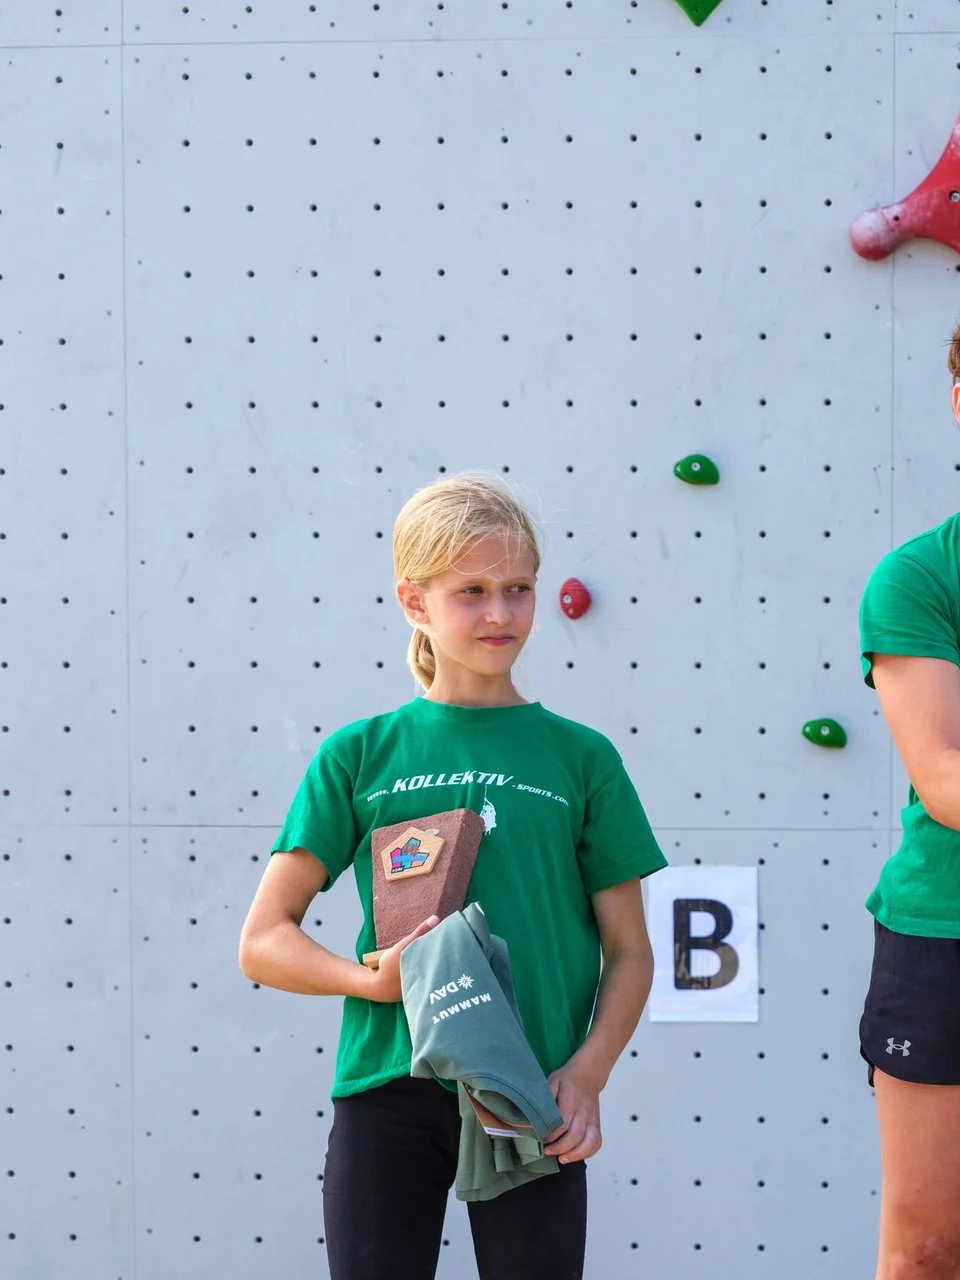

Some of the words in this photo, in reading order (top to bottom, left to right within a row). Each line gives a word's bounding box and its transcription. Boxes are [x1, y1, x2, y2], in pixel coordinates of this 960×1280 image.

[673, 898, 740, 991] B
[429, 981, 459, 1005] DAV
[432, 993, 492, 1025] MAMMUT
